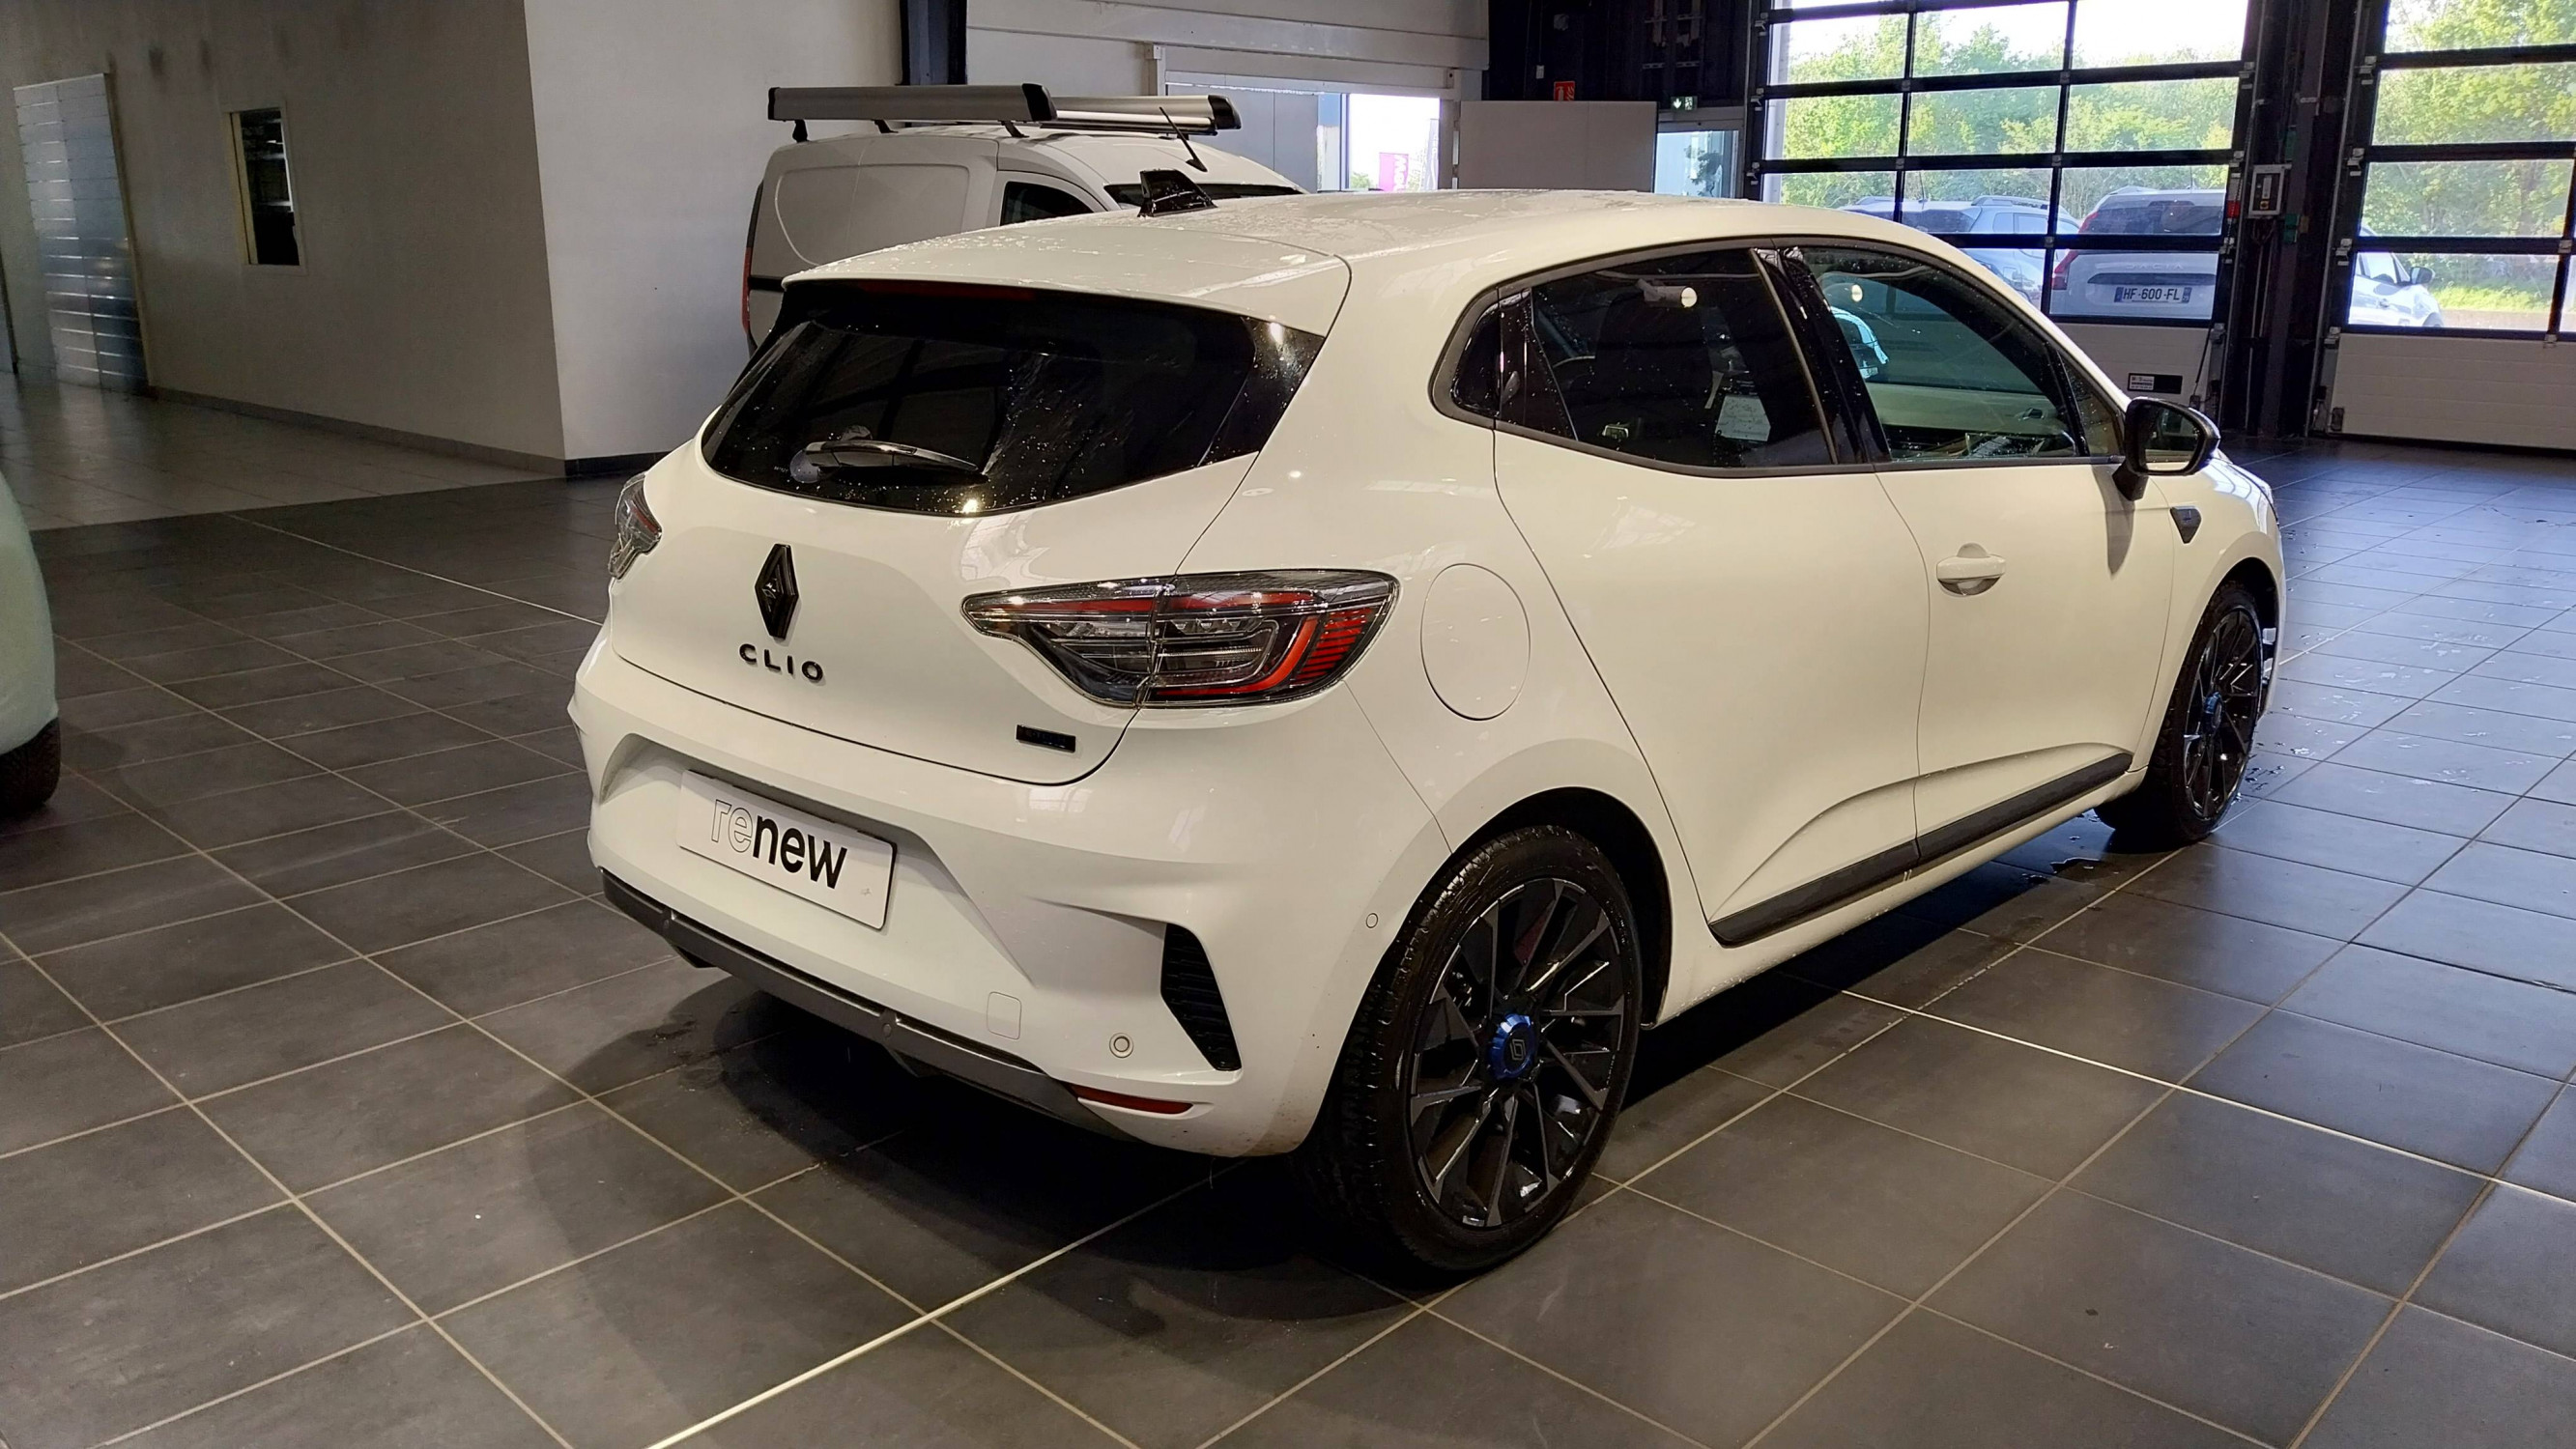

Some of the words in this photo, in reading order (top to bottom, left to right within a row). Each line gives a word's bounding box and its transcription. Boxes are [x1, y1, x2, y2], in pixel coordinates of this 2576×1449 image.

[2123, 288, 2180, 300] HF-600-FL
[738, 643, 824, 682] CLIO
[711, 799, 848, 890] renew
